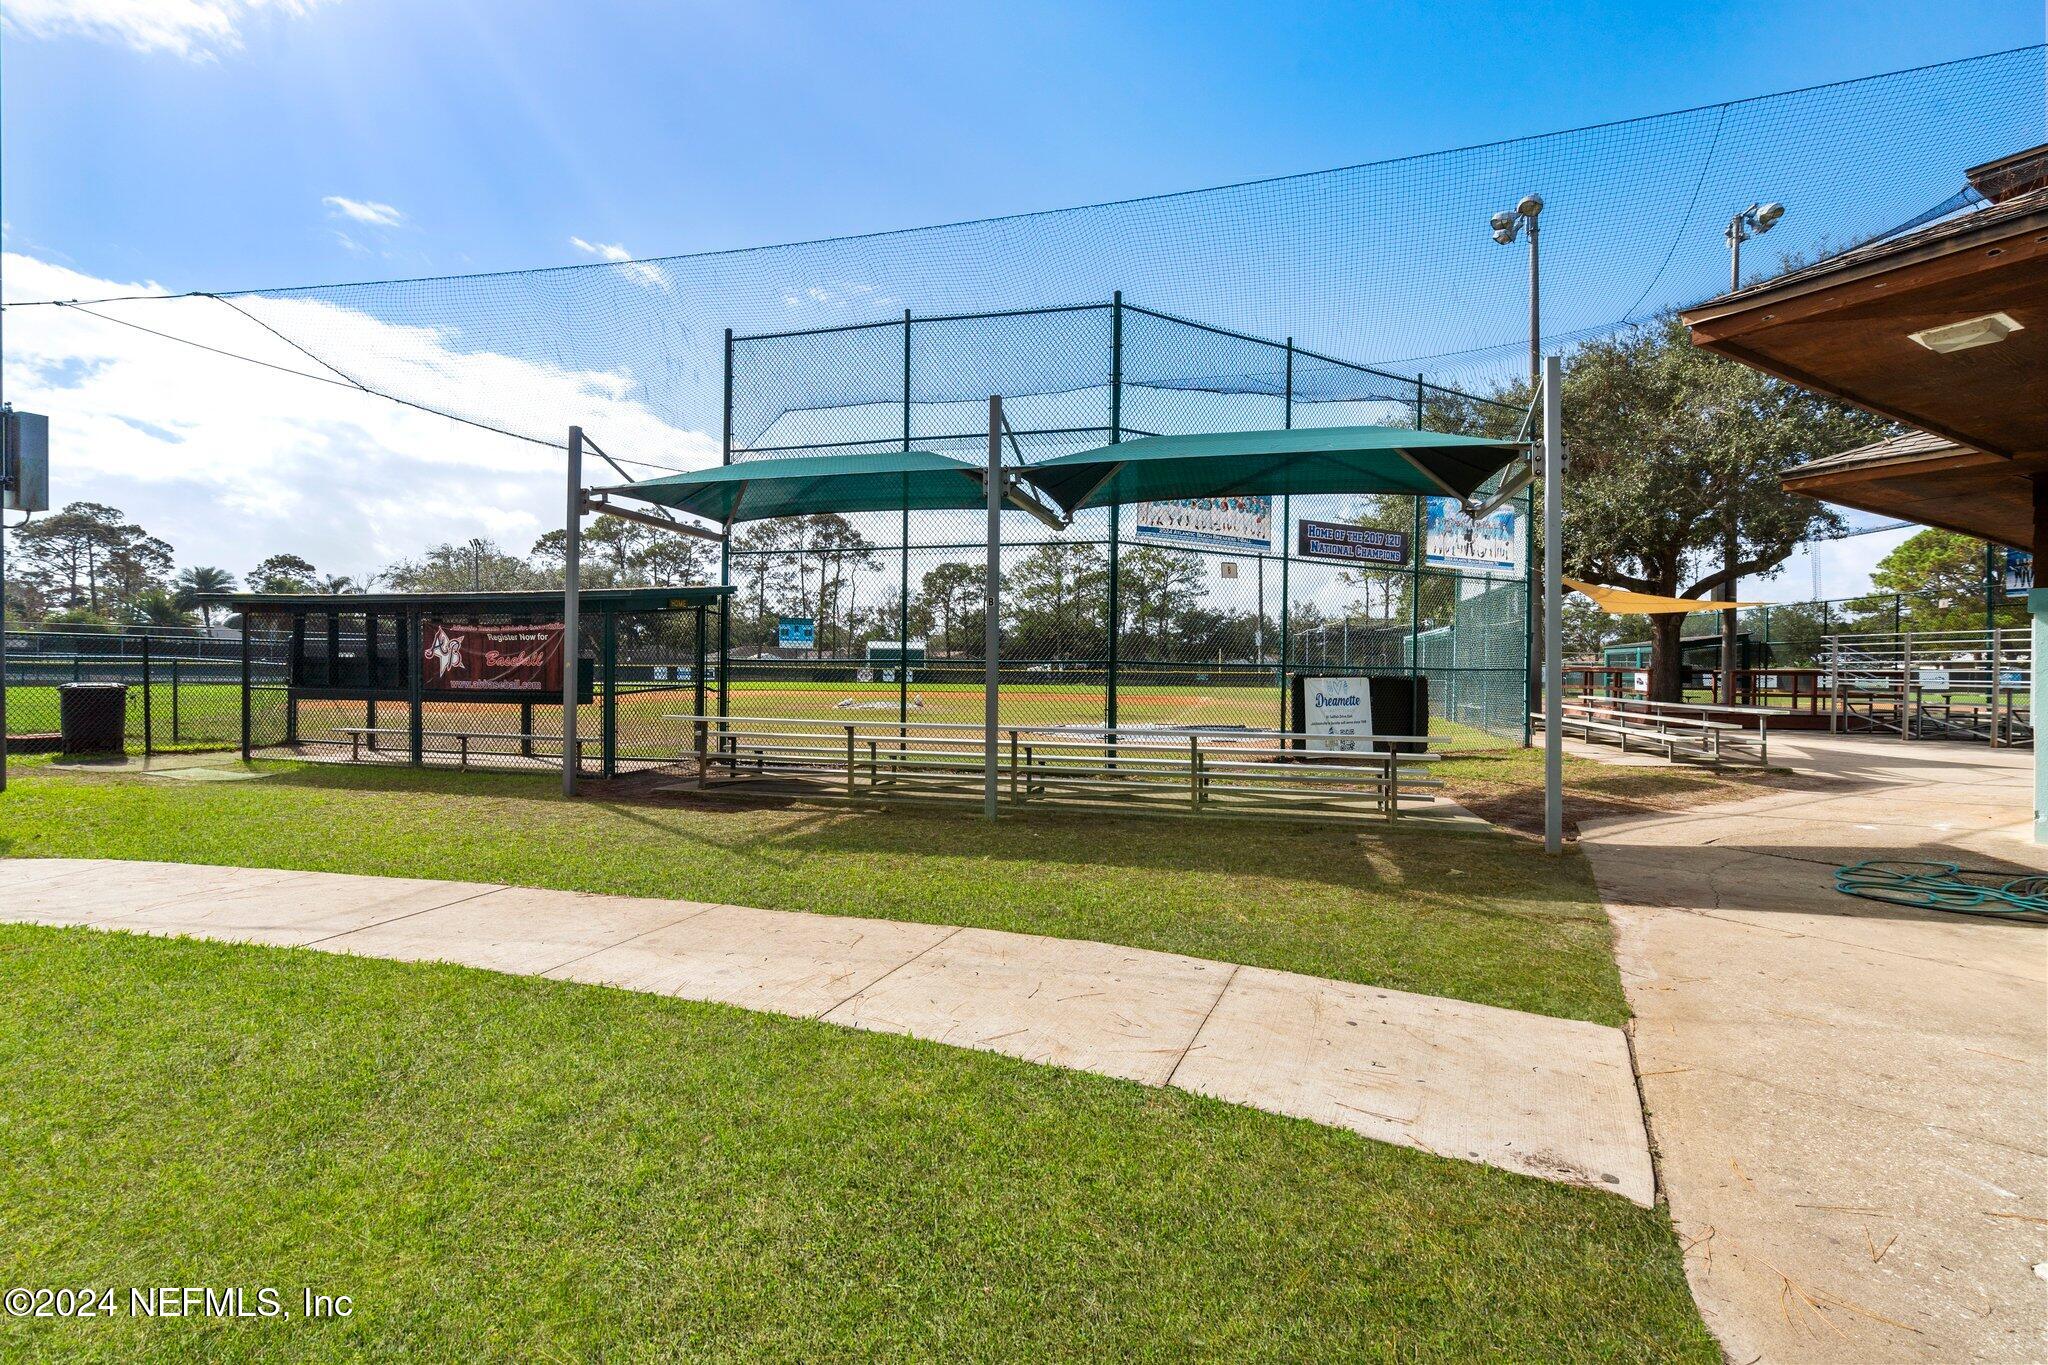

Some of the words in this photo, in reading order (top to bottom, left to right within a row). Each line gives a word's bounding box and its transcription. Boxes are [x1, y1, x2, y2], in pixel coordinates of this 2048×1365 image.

[1308, 524, 1333, 539] HOME
[1334, 530, 1346, 541] OF
[1347, 531, 1363, 543] THE
[1364, 531, 1384, 545] 2017
[1385, 534, 1402, 547] 12U
[1310, 540, 1354, 557] NATIONAL
[1355, 545, 1401, 562] CHAMPIONS
[487, 633, 518, 643] Register
[519, 633, 536, 641] Now
[537, 632, 548, 641] for
[485, 650, 544, 667] Baseball
[450, 679, 542, 690] www.abbaseball.com
[1315, 692, 1361, 708] Dreamette
